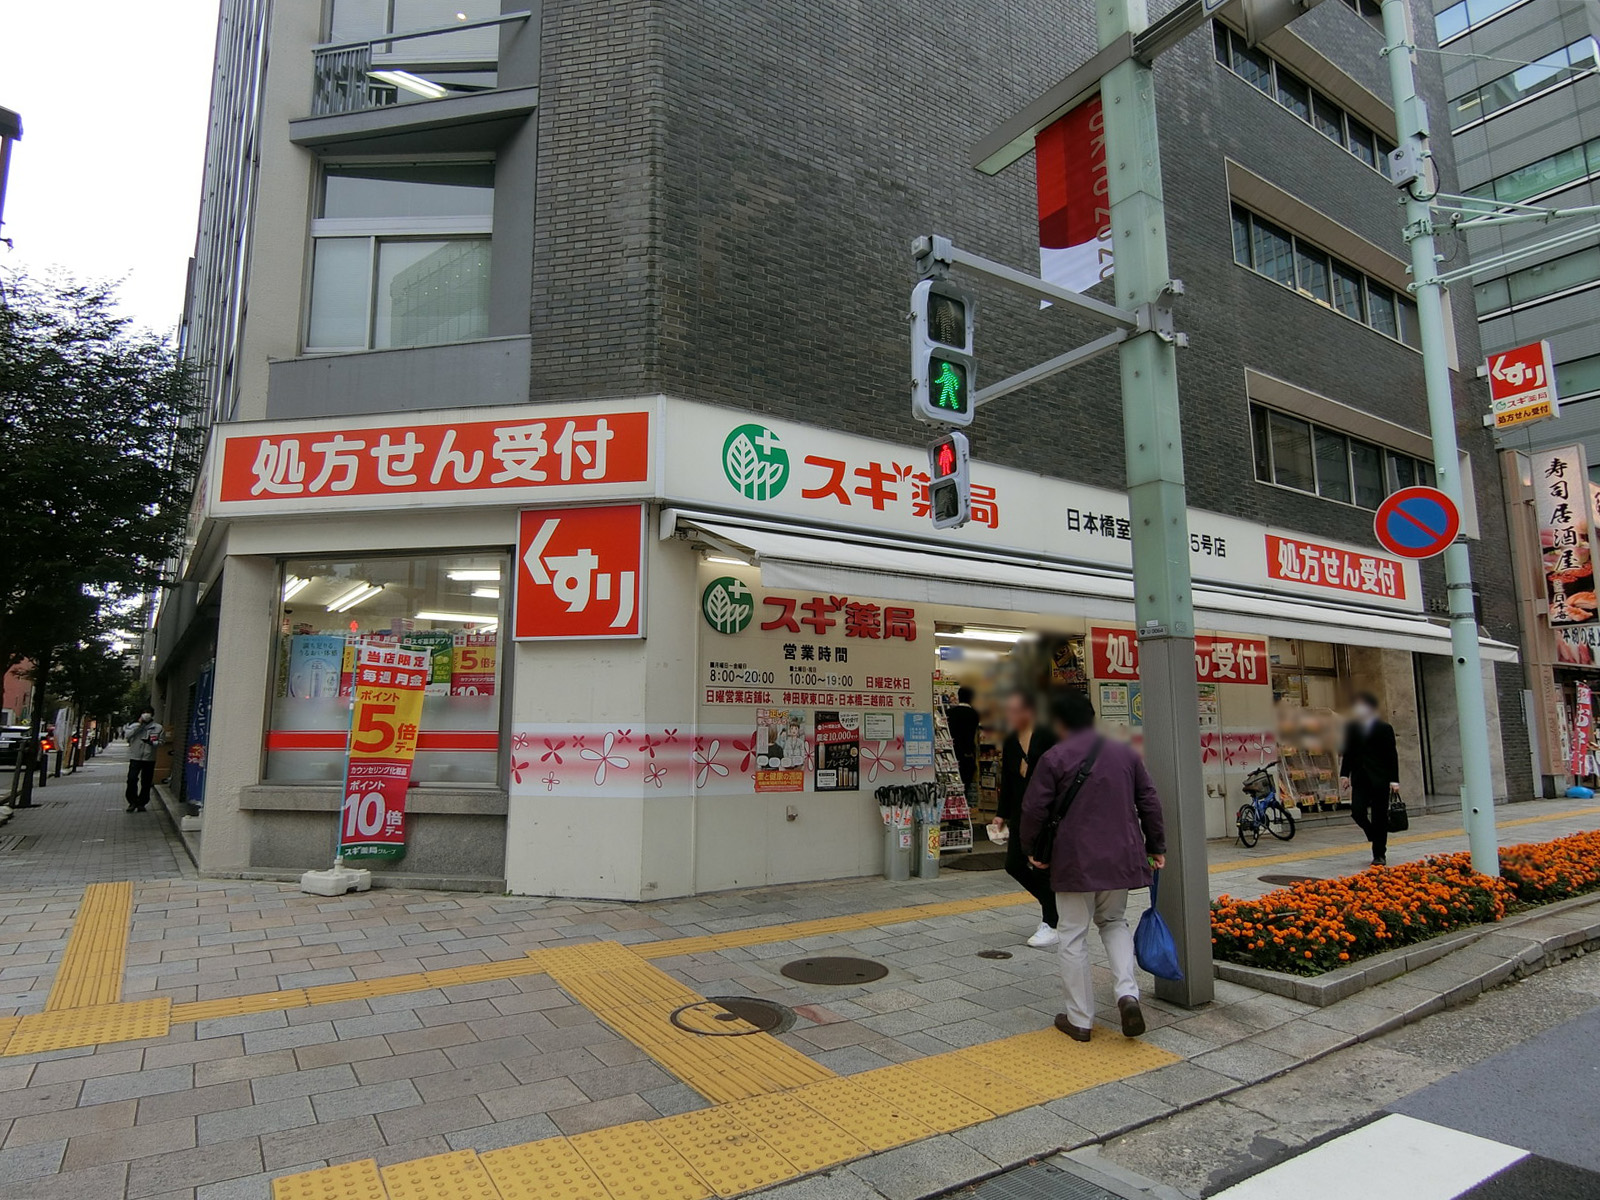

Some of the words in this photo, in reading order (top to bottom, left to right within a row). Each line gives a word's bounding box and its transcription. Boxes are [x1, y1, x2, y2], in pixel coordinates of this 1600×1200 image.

[1491, 355, 1545, 387] くすり
[1507, 392, 1548, 409] スギ薬局
[1497, 405, 1548, 424] 処方せん受付
[250, 417, 615, 496] 処方せん受付
[1544, 457, 1581, 571] 寿司居酒屋
[523, 518, 635, 629] くすり
[1277, 538, 1397, 597] 処方せん受付
[760, 595, 917, 642] スギ薬局
[367, 650, 425, 668] 当店限定
[460, 650, 478, 670] 5
[783, 642, 849, 663] 営業時間
[1106, 632, 1257, 680] 処ん受付
[865, 676, 911, 690] 日曜定休日
[360, 689, 400, 703] ポイント
[353, 703, 396, 753] 5
[397, 723, 417, 741] 倍
[394, 741, 414, 753] デー
[350, 766, 408, 776] カウンセリング化粧品
[350, 780, 386, 791] ポイント
[344, 792, 386, 837] 10
[386, 810, 403, 826] 倍
[385, 825, 403, 837] デー
